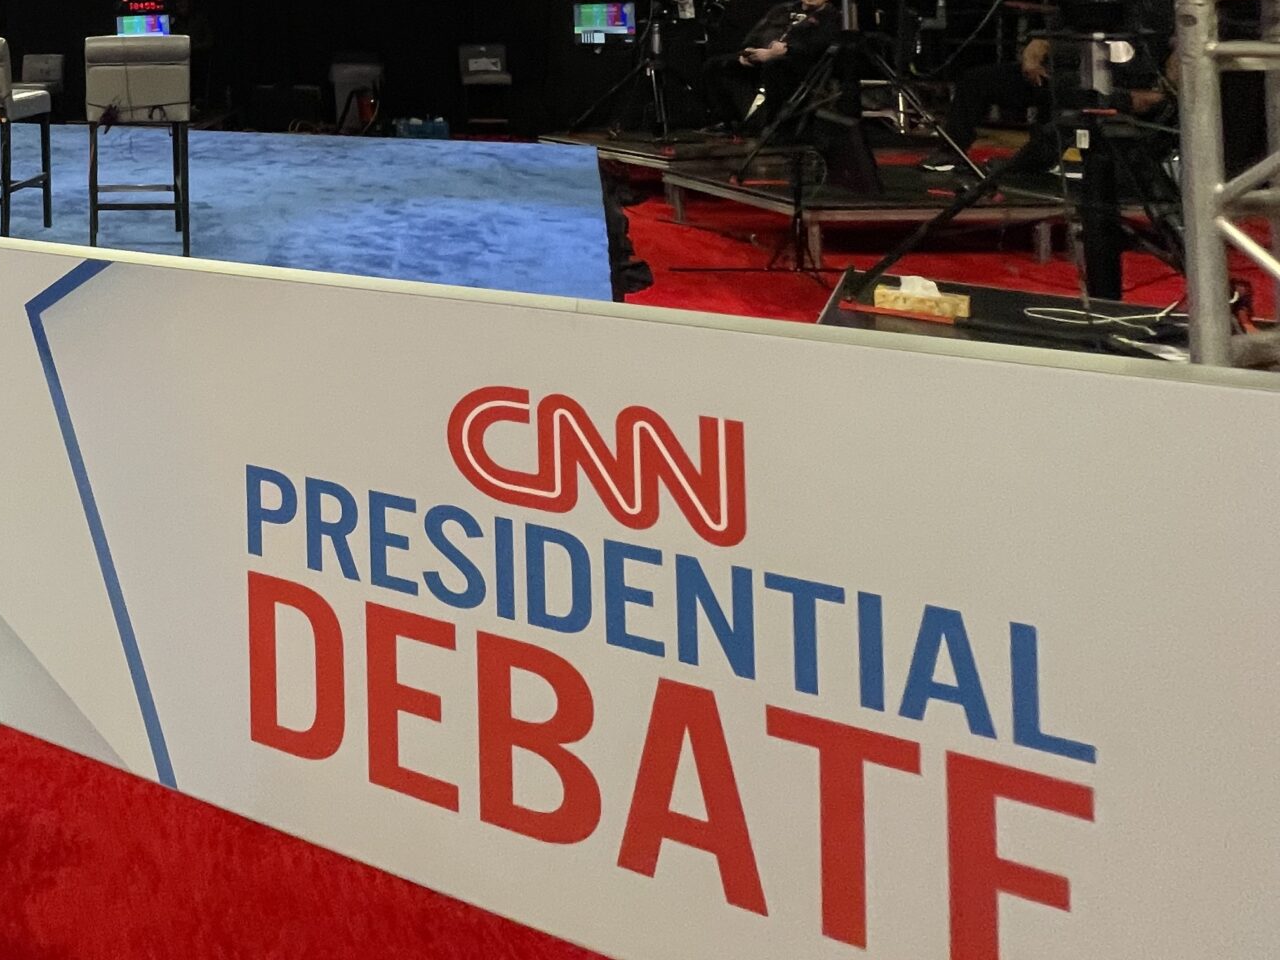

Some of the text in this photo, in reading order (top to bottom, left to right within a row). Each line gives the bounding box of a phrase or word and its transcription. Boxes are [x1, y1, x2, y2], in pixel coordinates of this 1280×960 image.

[244, 463, 1097, 765] PRESIDENTIAL
[446, 384, 747, 547] CNN
[247, 569, 1096, 960] DEBATE
